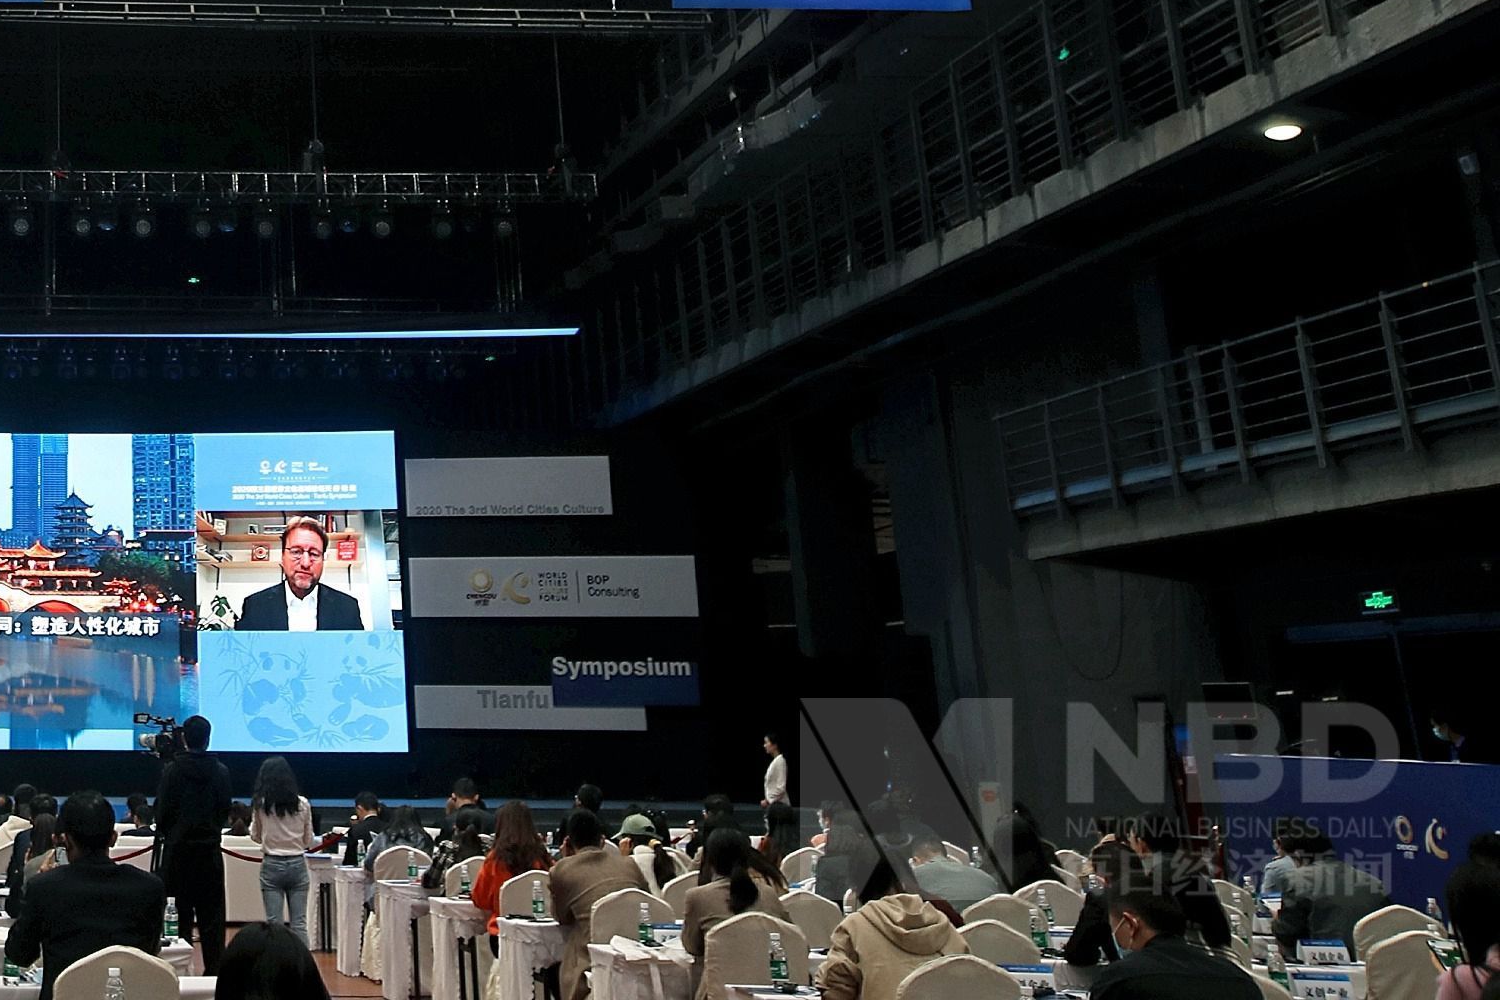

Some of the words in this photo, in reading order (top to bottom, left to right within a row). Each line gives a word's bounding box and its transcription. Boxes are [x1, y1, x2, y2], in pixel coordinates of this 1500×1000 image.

[415, 506, 442, 516] 2020
[444, 505, 466, 516] The
[468, 505, 488, 515] 3rd
[490, 505, 524, 515] World
[526, 504, 560, 515] Cities
[562, 504, 605, 515] Culture
[537, 571, 568, 580] WORLD
[587, 574, 610, 585] BOP
[537, 579, 569, 587] CITIES
[538, 594, 569, 602] FORUM
[587, 586, 641, 600] Consulting
[552, 657, 692, 681] Symposium
[476, 689, 550, 710] Tianfu
